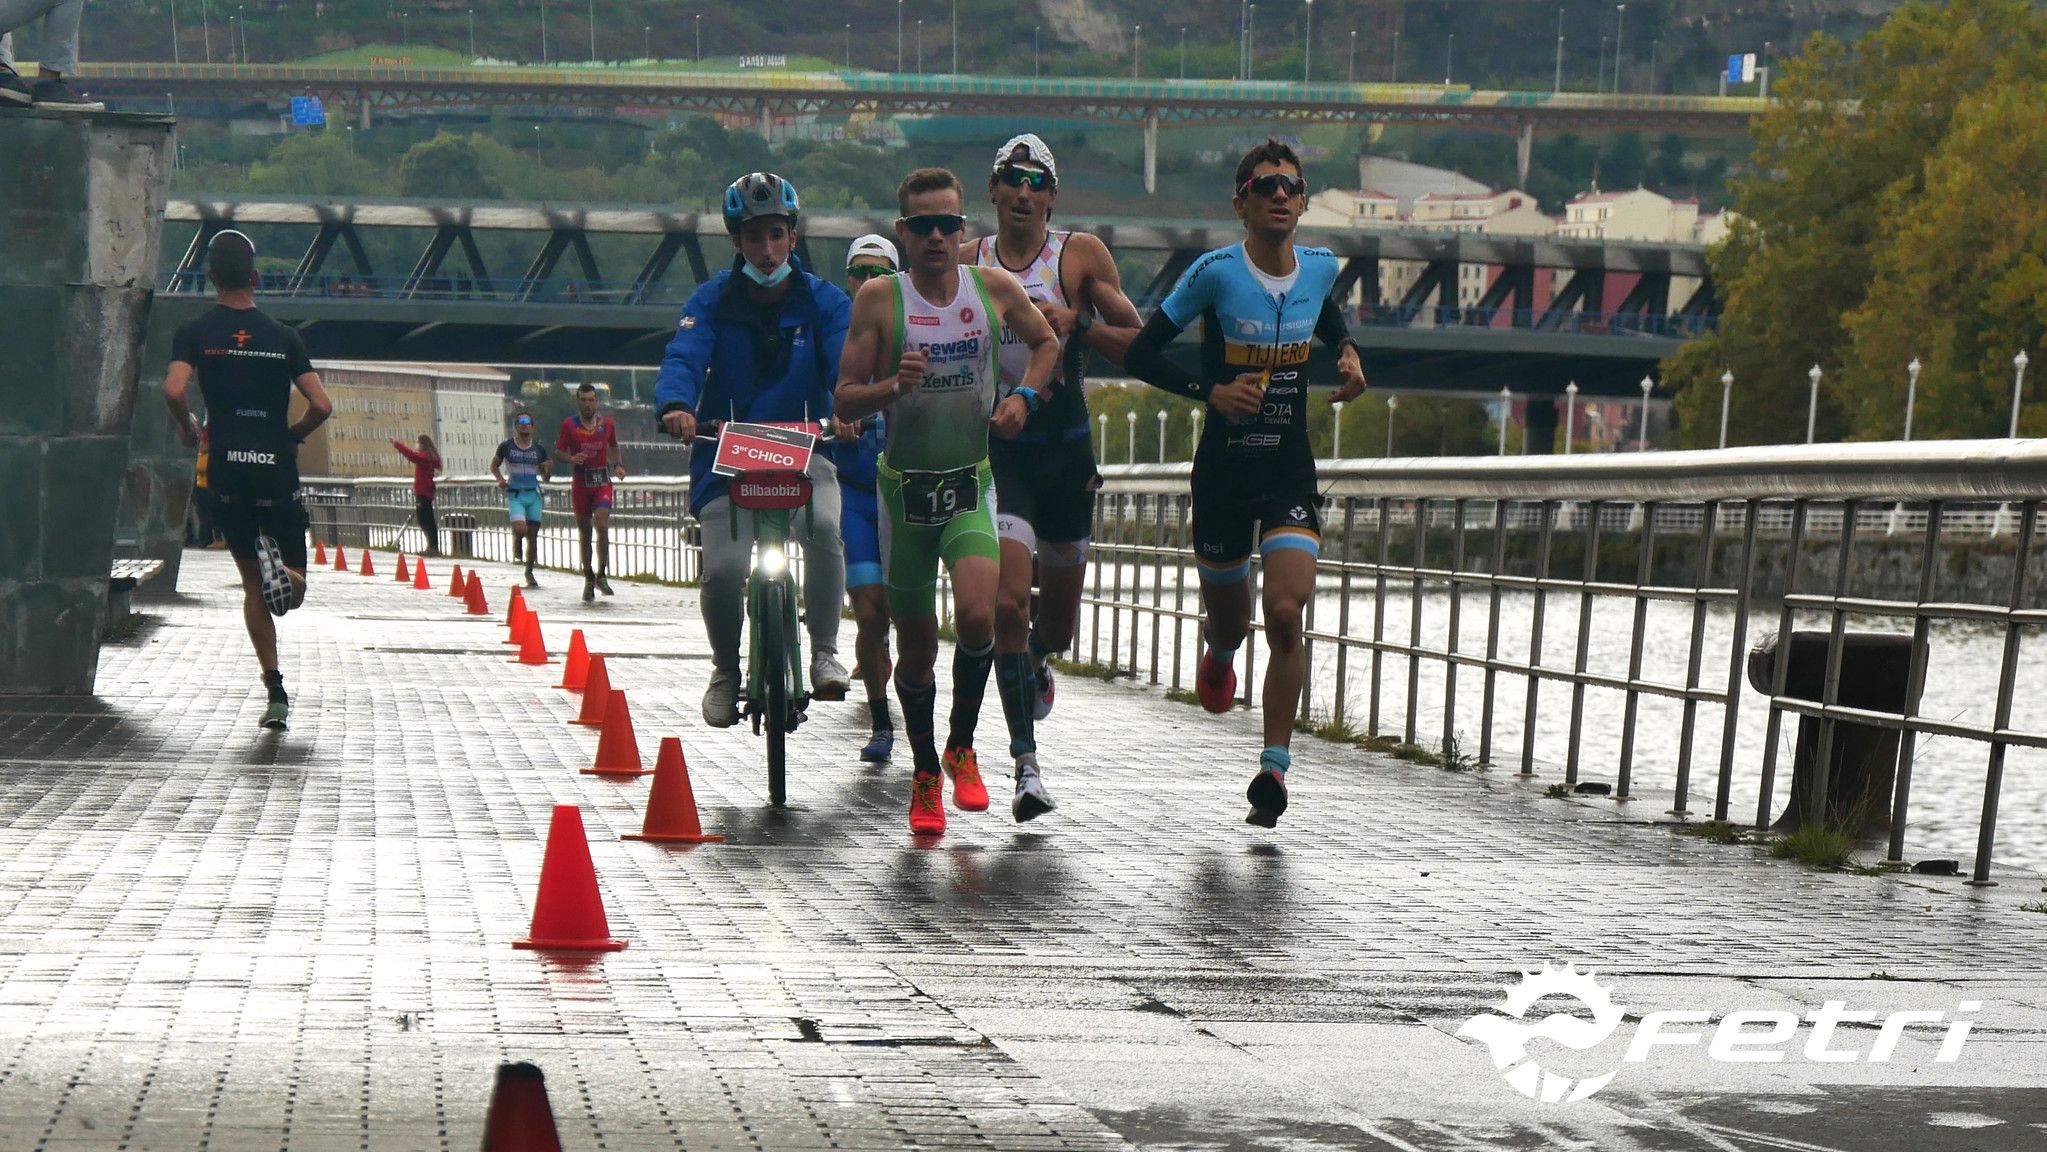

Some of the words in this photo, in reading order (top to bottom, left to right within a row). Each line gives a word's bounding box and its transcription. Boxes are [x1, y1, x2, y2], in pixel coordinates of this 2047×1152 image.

[1187, 253, 1234, 288] ORBEA
[1264, 417, 1291, 425] DENTAL
[1227, 432, 1281, 447] HGB
[226, 450, 276, 465] MUÑOZ
[747, 448, 795, 466] CHICO
[740, 484, 801, 497] Bilbaobizi
[926, 489, 957, 513] 19
